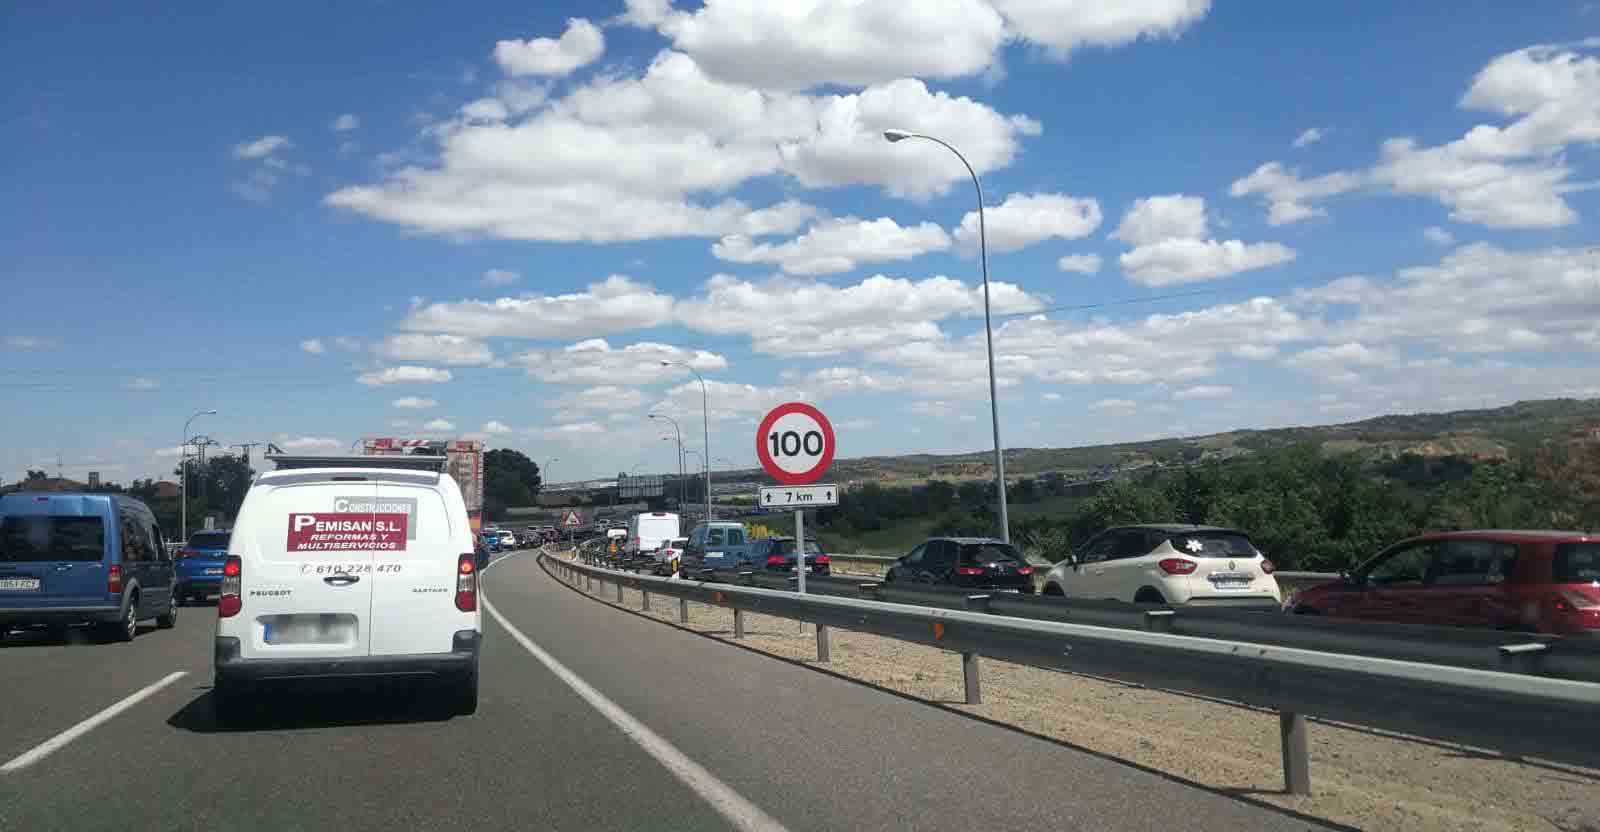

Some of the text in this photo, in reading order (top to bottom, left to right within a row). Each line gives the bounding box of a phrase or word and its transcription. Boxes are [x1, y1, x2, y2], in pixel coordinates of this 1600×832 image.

[769, 430, 823, 457] 100
[785, 491, 813, 503] 7 km
[294, 514, 372, 532] PEMISAN
[381, 533, 389, 541] Y
[297, 541, 397, 551] MULTISERVICIOS
